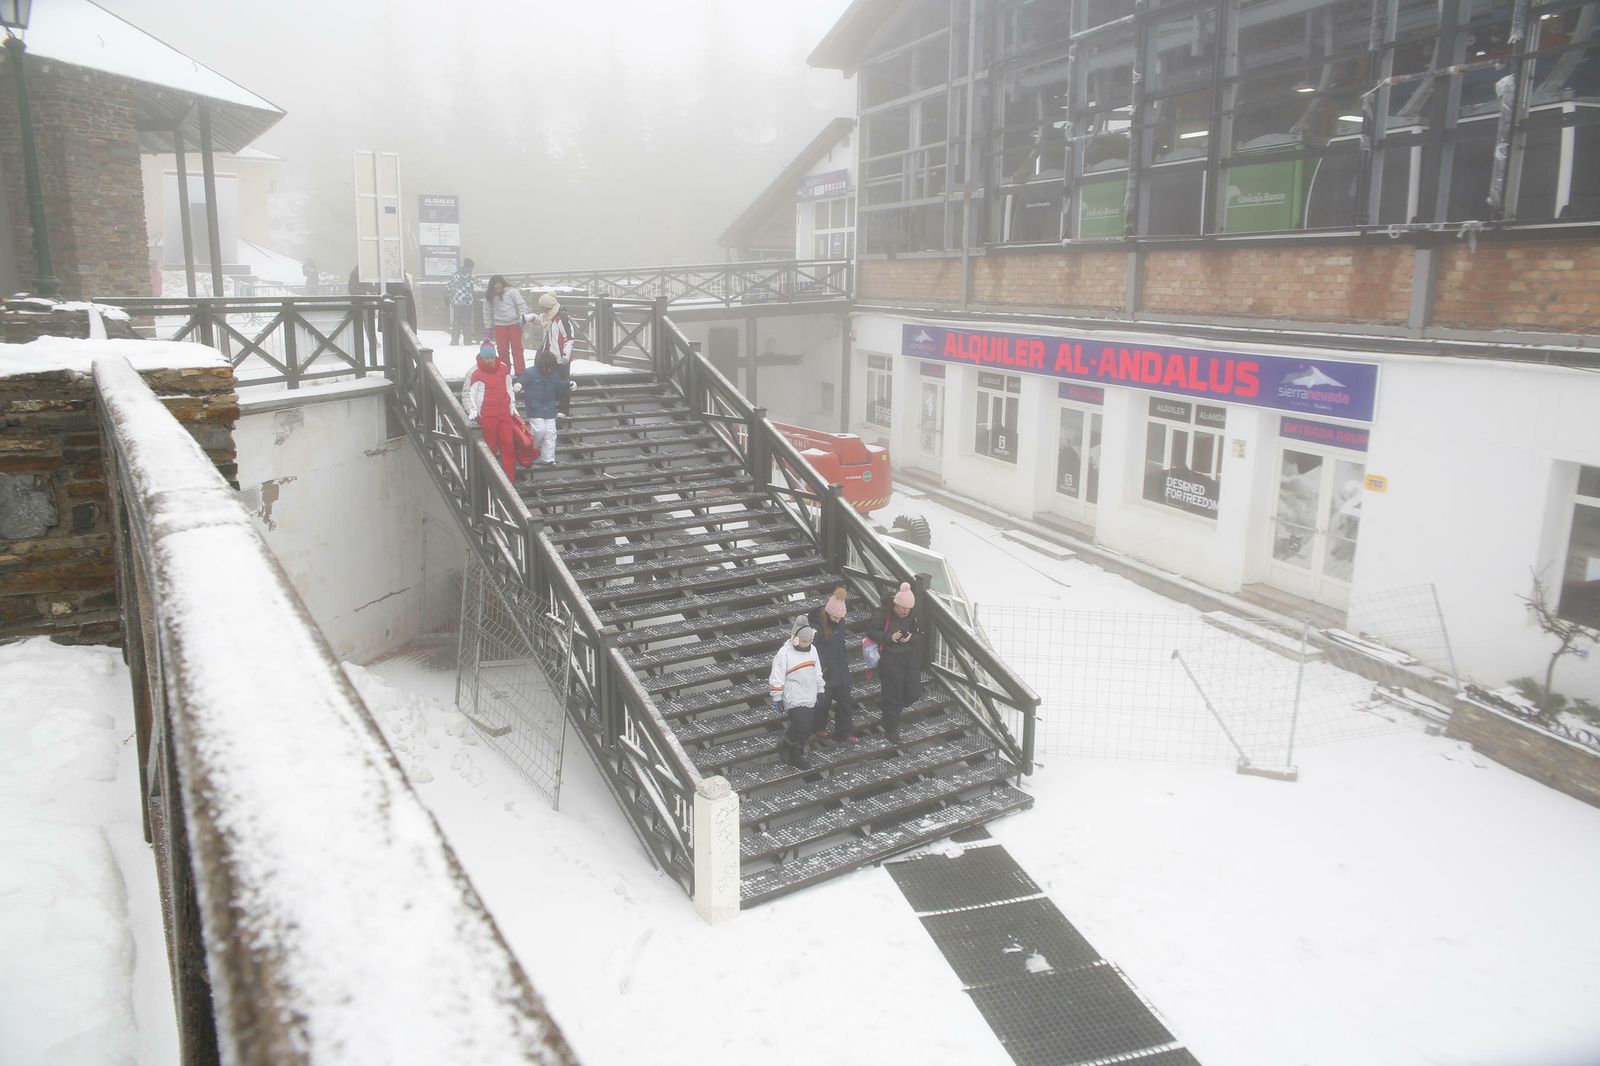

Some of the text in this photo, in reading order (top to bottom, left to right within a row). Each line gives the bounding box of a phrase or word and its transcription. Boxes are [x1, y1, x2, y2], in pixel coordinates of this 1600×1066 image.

[944, 332, 1045, 369] ALQUILER
[1156, 403, 1186, 416] ALQUILER
[1284, 422, 1335, 441] ENTRADA
[1165, 487, 1183, 501] FOR
[1166, 476, 1206, 496] DESIGNED
